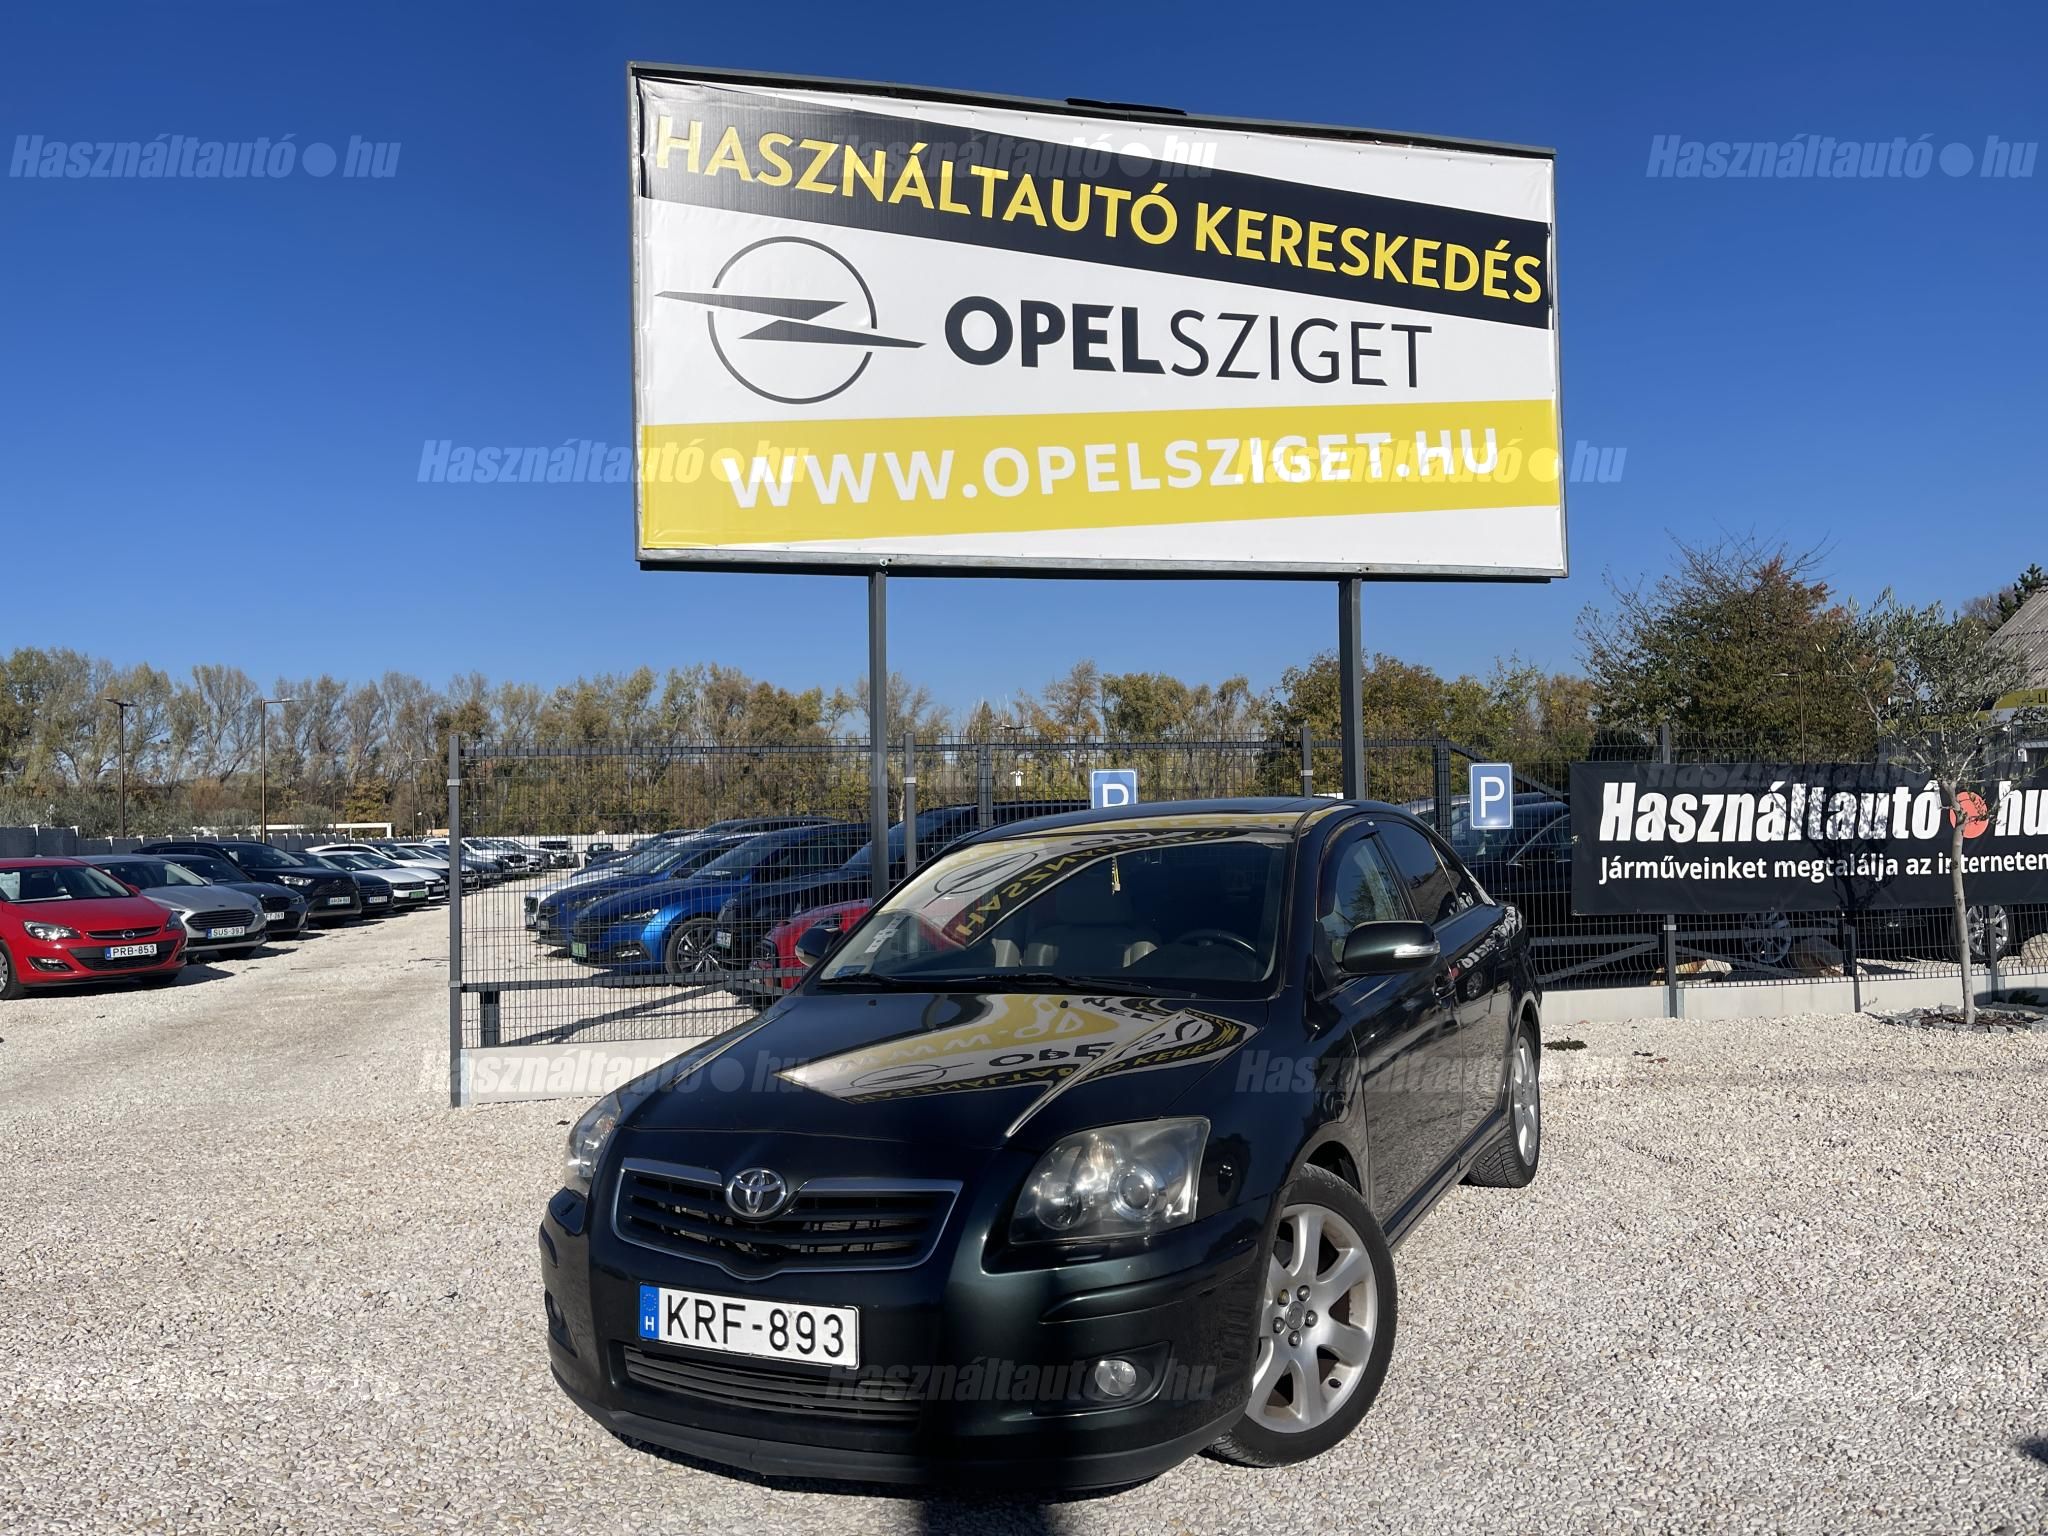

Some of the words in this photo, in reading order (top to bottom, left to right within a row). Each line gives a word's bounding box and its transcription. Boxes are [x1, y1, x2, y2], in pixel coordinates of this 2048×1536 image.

[655, 114, 1178, 246] HASZNÁLTAUTÓ
[1194, 202, 1543, 305] KERESKEDÉS
[944, 295, 1433, 389] OPELSZIGET
[721, 427, 1498, 509] WWW.OPELSZIGET.HU
[1480, 776, 1506, 818] P
[1598, 855, 1768, 885] Járműveinket
[1773, 853, 1899, 884] megtalálja
[1905, 857, 1932, 876] az
[112, 944, 156, 957] PRB-853
[212, 927, 244, 937] SUS-393
[666, 1294, 845, 1359] KRF-893
